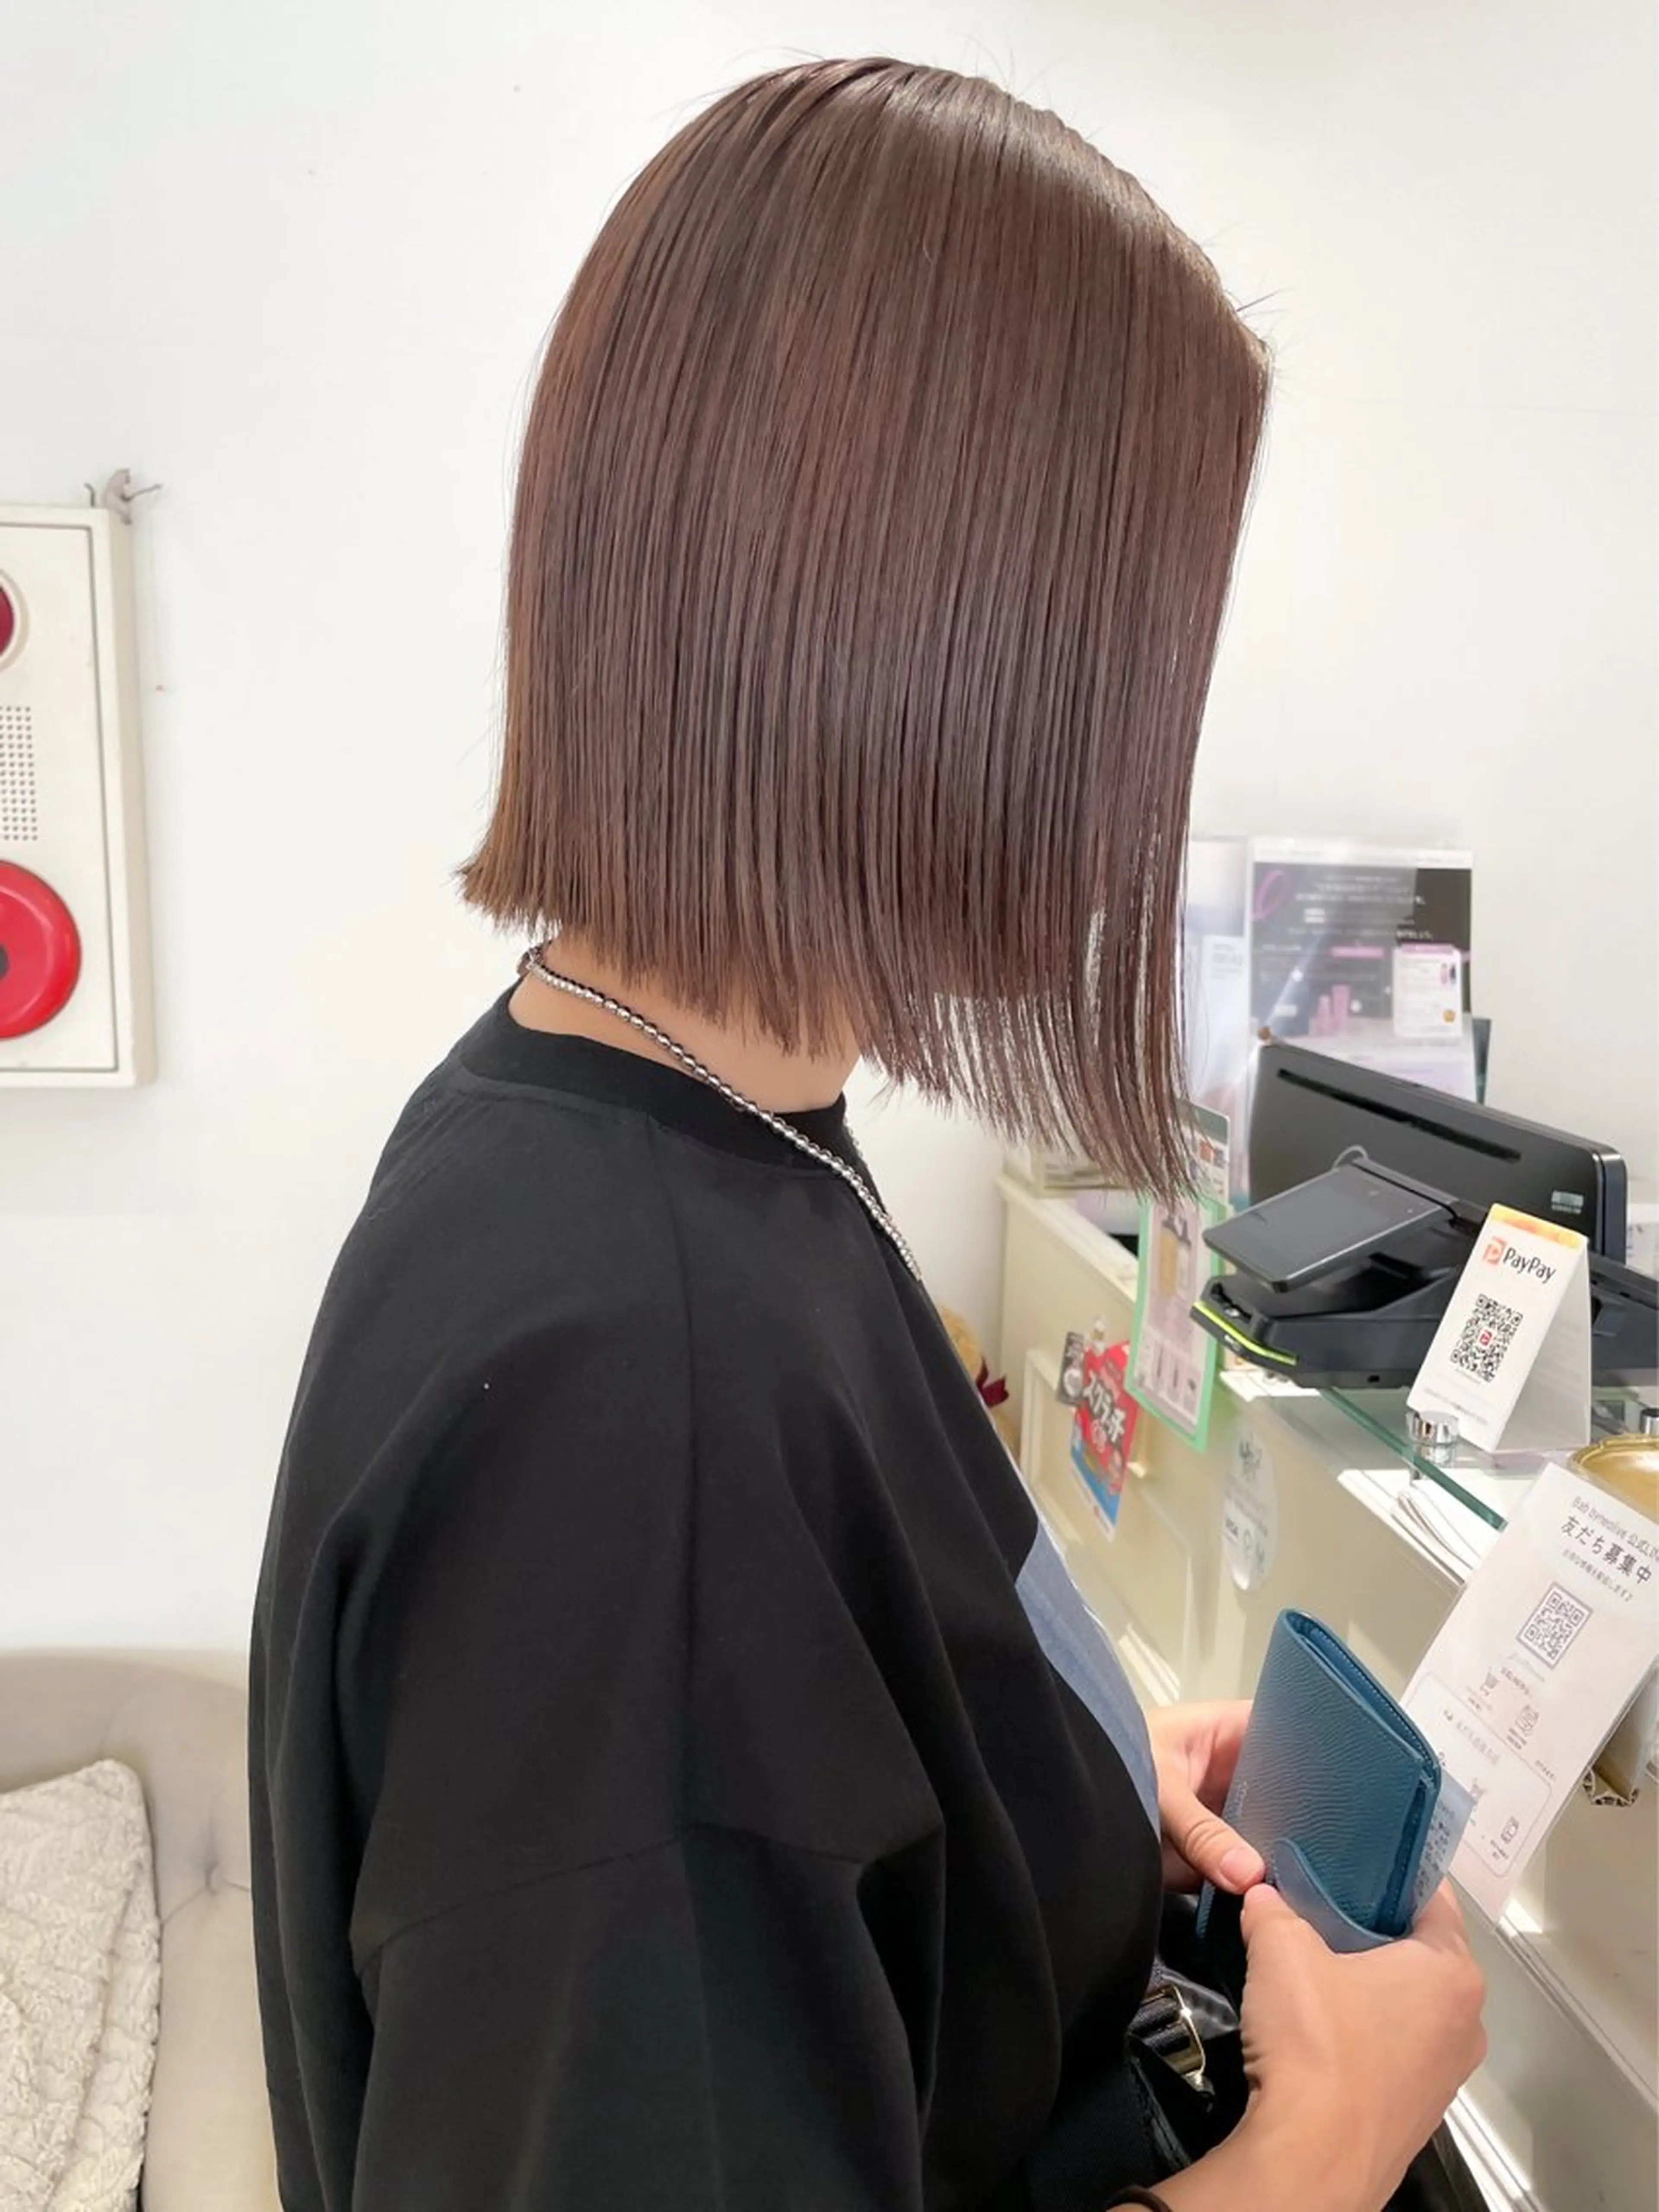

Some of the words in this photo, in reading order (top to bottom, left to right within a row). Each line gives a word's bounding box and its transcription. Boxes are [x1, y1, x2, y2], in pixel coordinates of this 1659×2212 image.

[1503, 1246, 1557, 1284] PayPay
[1561, 1516, 1652, 1584] 友だち募集中
